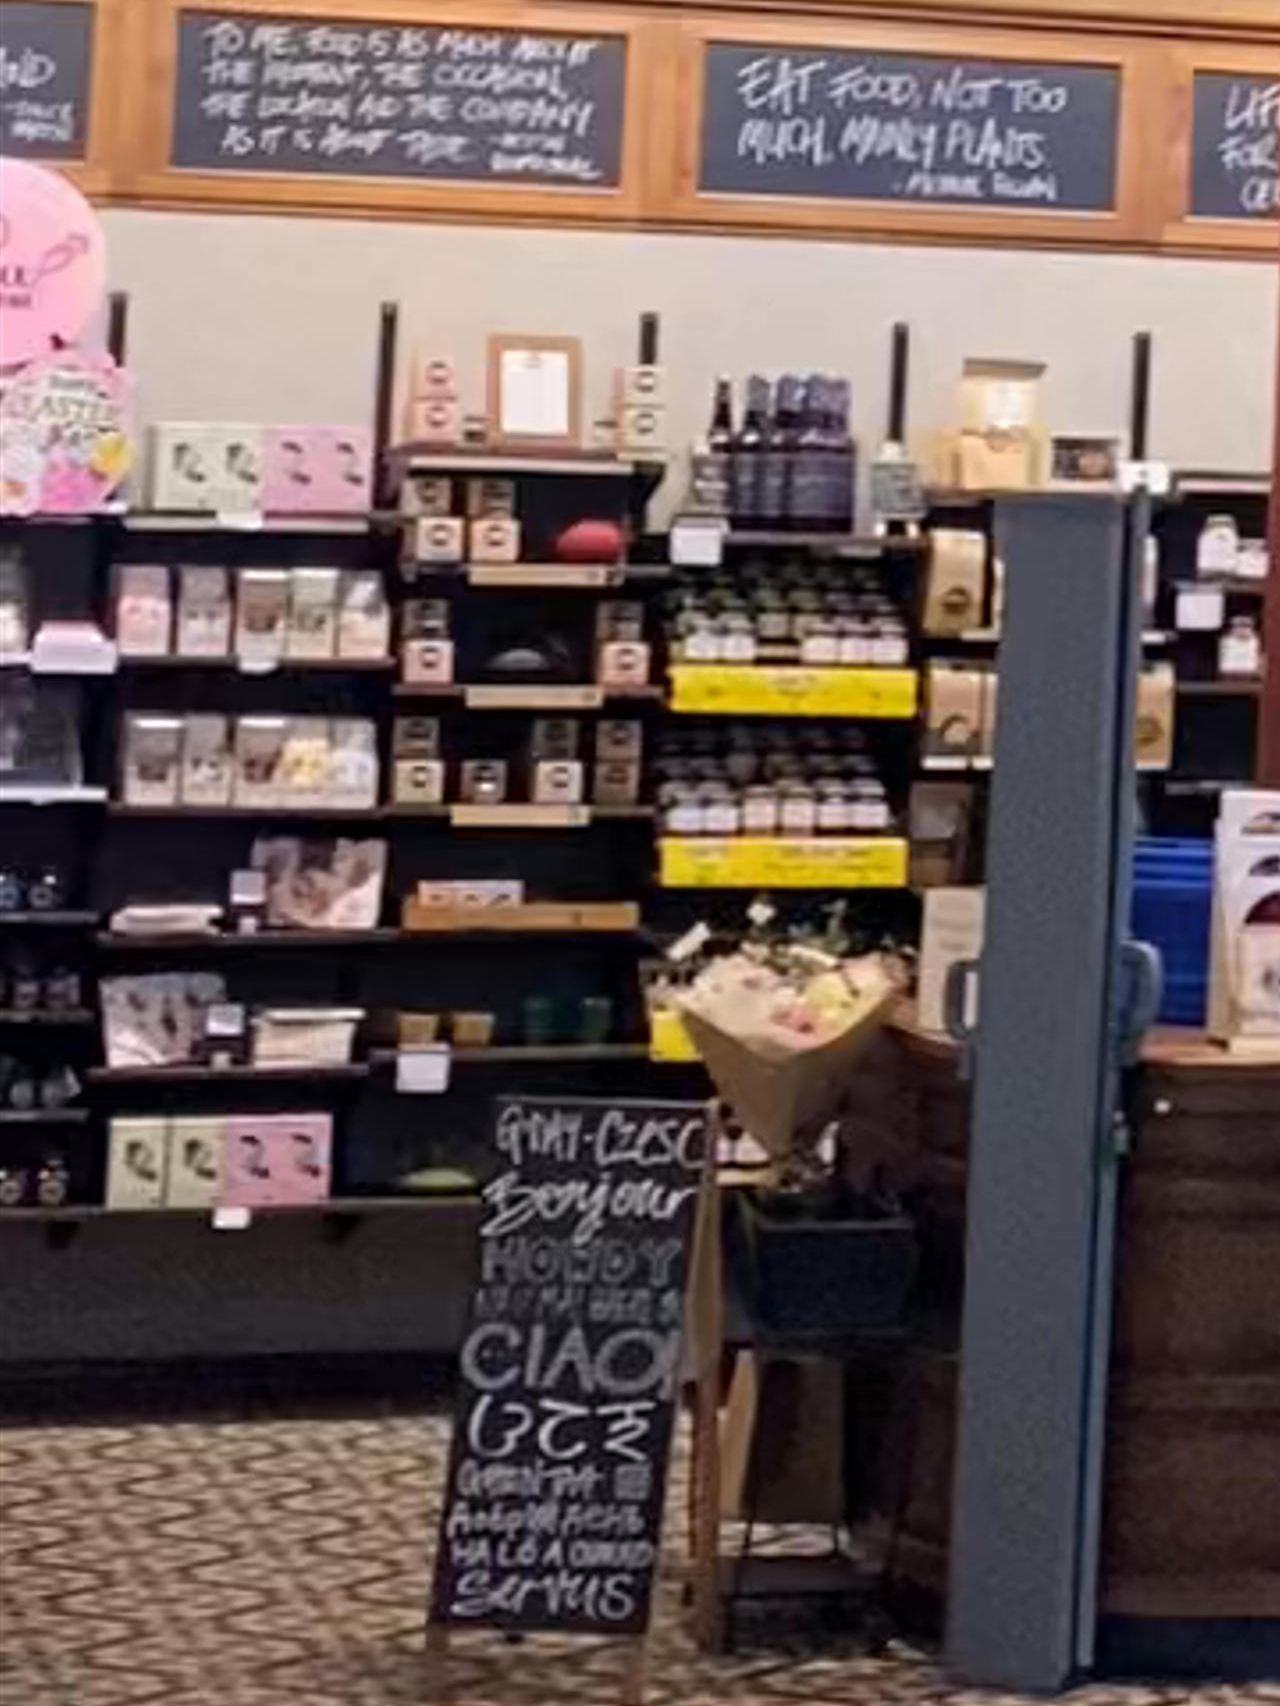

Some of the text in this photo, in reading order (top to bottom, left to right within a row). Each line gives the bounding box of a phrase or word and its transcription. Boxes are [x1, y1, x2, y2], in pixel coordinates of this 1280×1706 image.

[736, 56, 827, 115] EAT
[930, 67, 1004, 113] NOT
[1006, 77, 1068, 114] TOO
[479, 1170, 698, 1246] Bonjour
[481, 1238, 683, 1286] HOWDY
